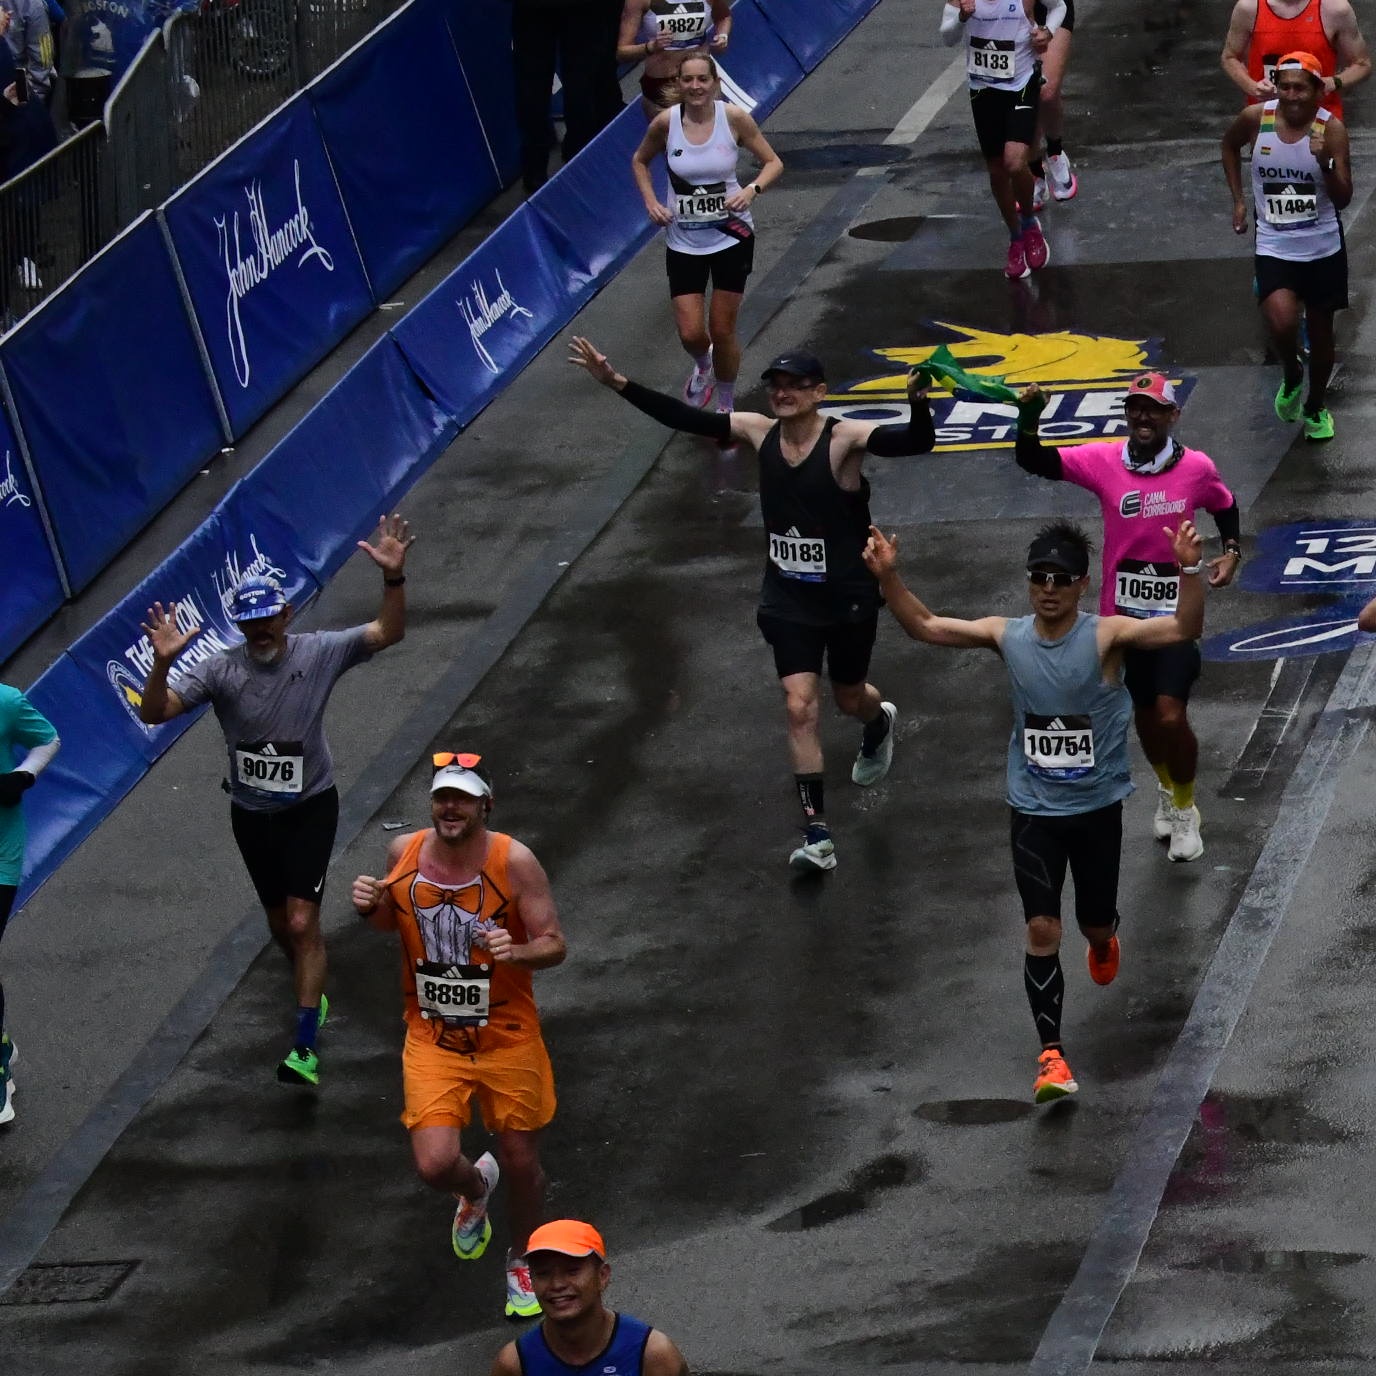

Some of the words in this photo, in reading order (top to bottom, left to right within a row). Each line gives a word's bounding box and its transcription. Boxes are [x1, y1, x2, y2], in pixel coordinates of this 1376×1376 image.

[974, 51, 1009, 70] 8133
[1258, 166, 1314, 182] BOLIVIA
[678, 196, 726, 215] 11480
[772, 538, 825, 562] 10183
[1118, 577, 1178, 600] 10598
[1028, 735, 1092, 757] 10754
[243, 757, 294, 782] 9076
[424, 981, 481, 1006] 8896
